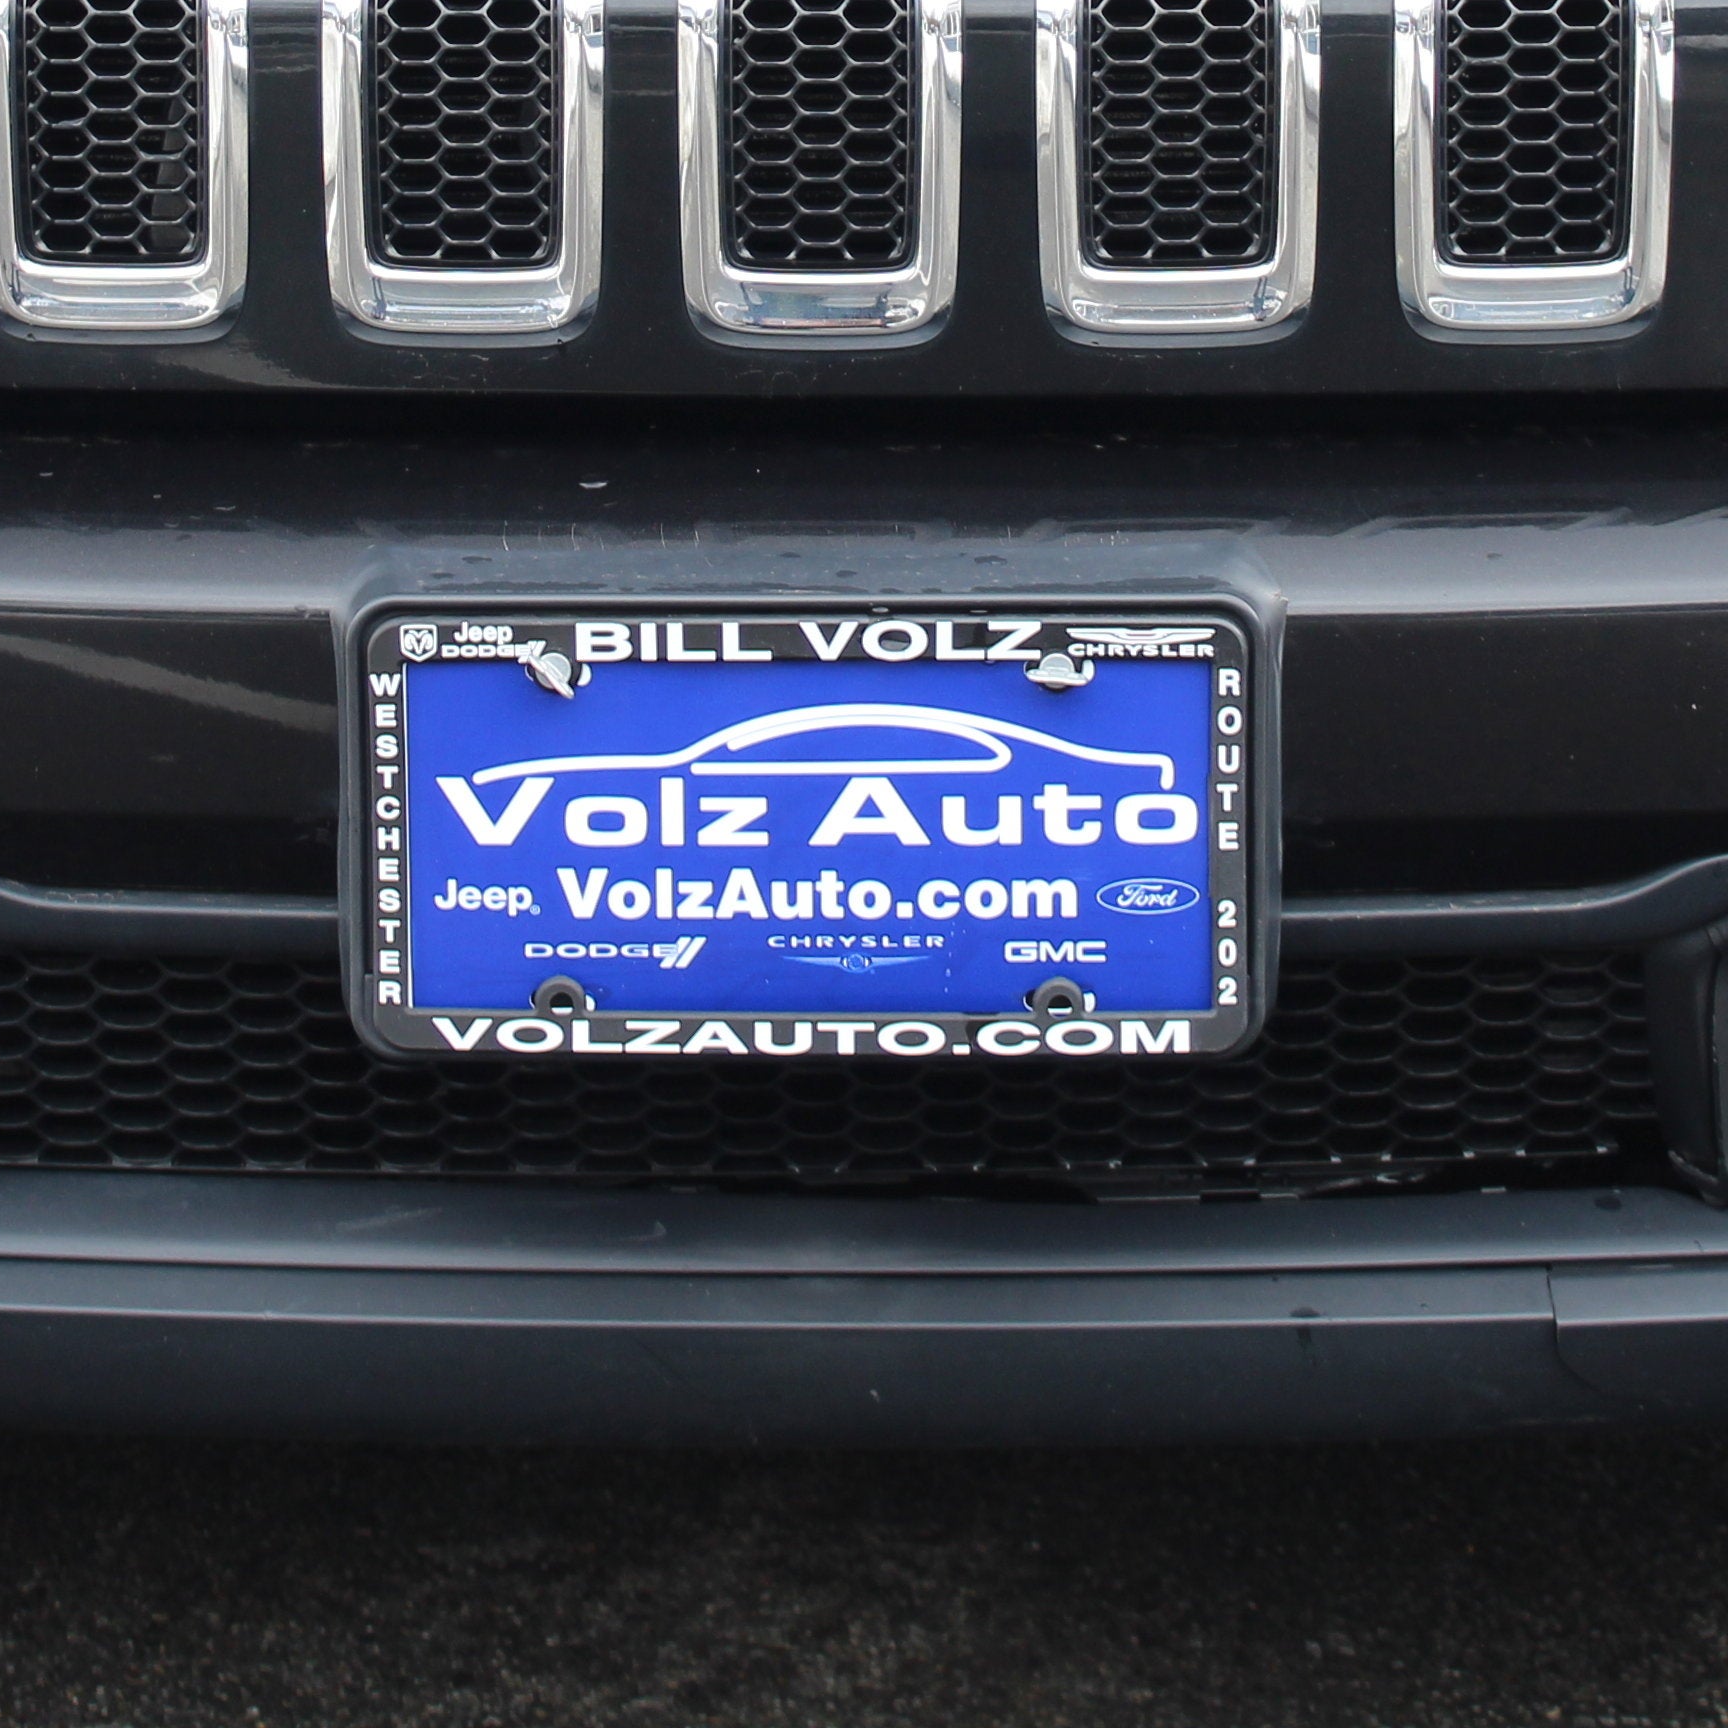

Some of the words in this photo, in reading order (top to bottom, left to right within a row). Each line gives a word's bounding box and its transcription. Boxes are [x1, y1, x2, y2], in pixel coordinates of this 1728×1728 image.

[440, 644, 530, 659] DODGE
[453, 621, 513, 645] Jeep
[574, 622, 773, 662] BILL
[798, 620, 1042, 662] VOLZ
[1067, 643, 1215, 658] CHRYSLER
[1216, 668, 1242, 852] ROUTE
[436, 776, 769, 847] Volz
[808, 776, 1199, 847] Auto
[369, 673, 403, 1006] WESTCHESTER
[434, 878, 535, 916] Jeep
[556, 867, 1078, 921] VolzAuto.com
[1116, 884, 1178, 908] Ford
[524, 941, 676, 960] DODGE
[768, 934, 945, 950] CHRYSLER
[1003, 940, 1107, 964] GMC
[1217, 900, 1239, 1006] 202
[432, 1017, 1192, 1056] VOLZAUTO.COM
